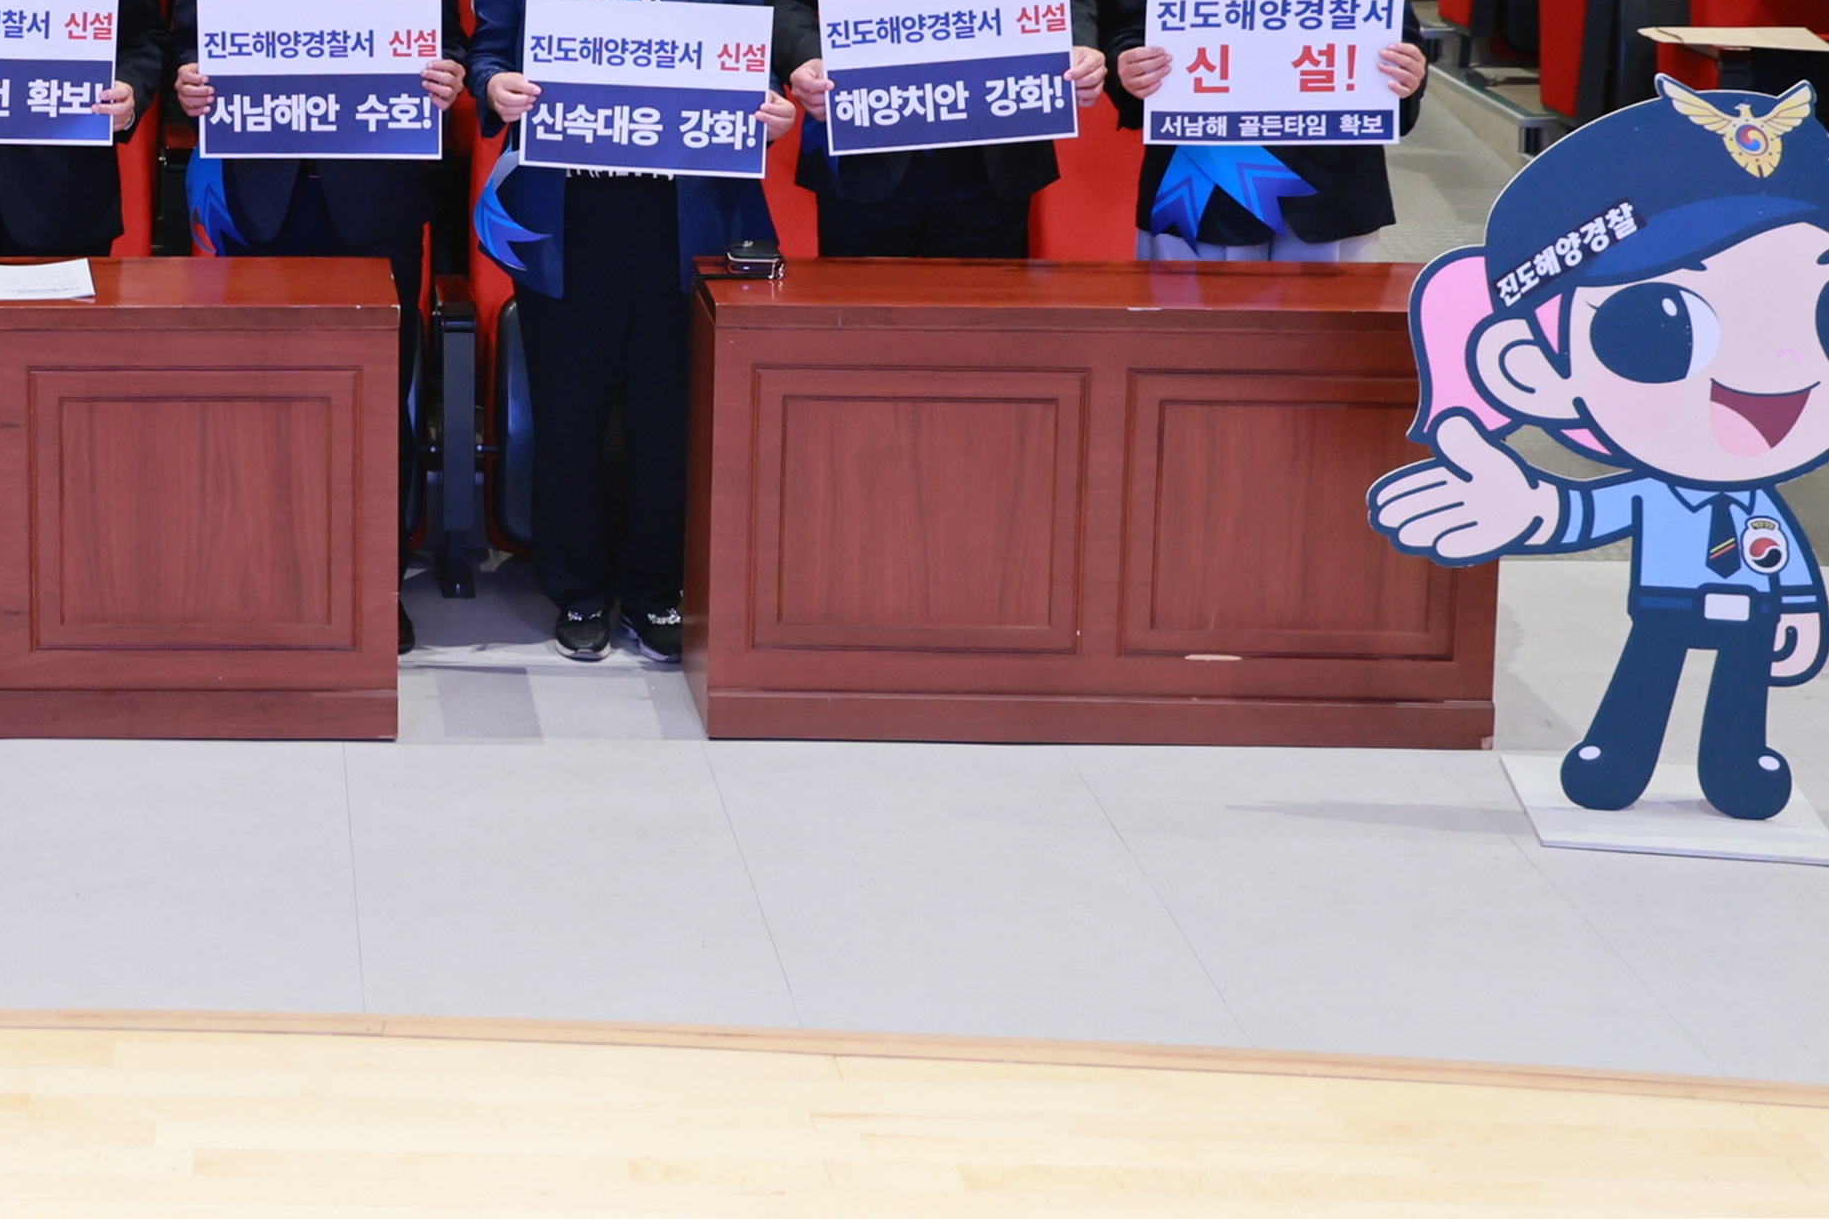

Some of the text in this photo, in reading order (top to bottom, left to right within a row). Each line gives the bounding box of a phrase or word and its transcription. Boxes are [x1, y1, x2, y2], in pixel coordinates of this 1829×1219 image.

[64, 12, 113, 40] 신설
[204, 28, 437, 59] 진도해양경찰서 신설
[826, 4, 1066, 48] 진도해양경찰서 신설
[530, 35, 765, 72] 진도해양경찰서 신설
[1186, 44, 1356, 94] 신 설!
[27, 79, 103, 117] 확보!
[210, 94, 431, 132] 서남해안 수호!
[835, 75, 1063, 128] 해양치안 강화!
[532, 102, 756, 150] 신속대응 강화!
[1161, 114, 1383, 137] 서남해 골든타임 확보
[1496, 203, 1640, 307] 진도해양경찰
